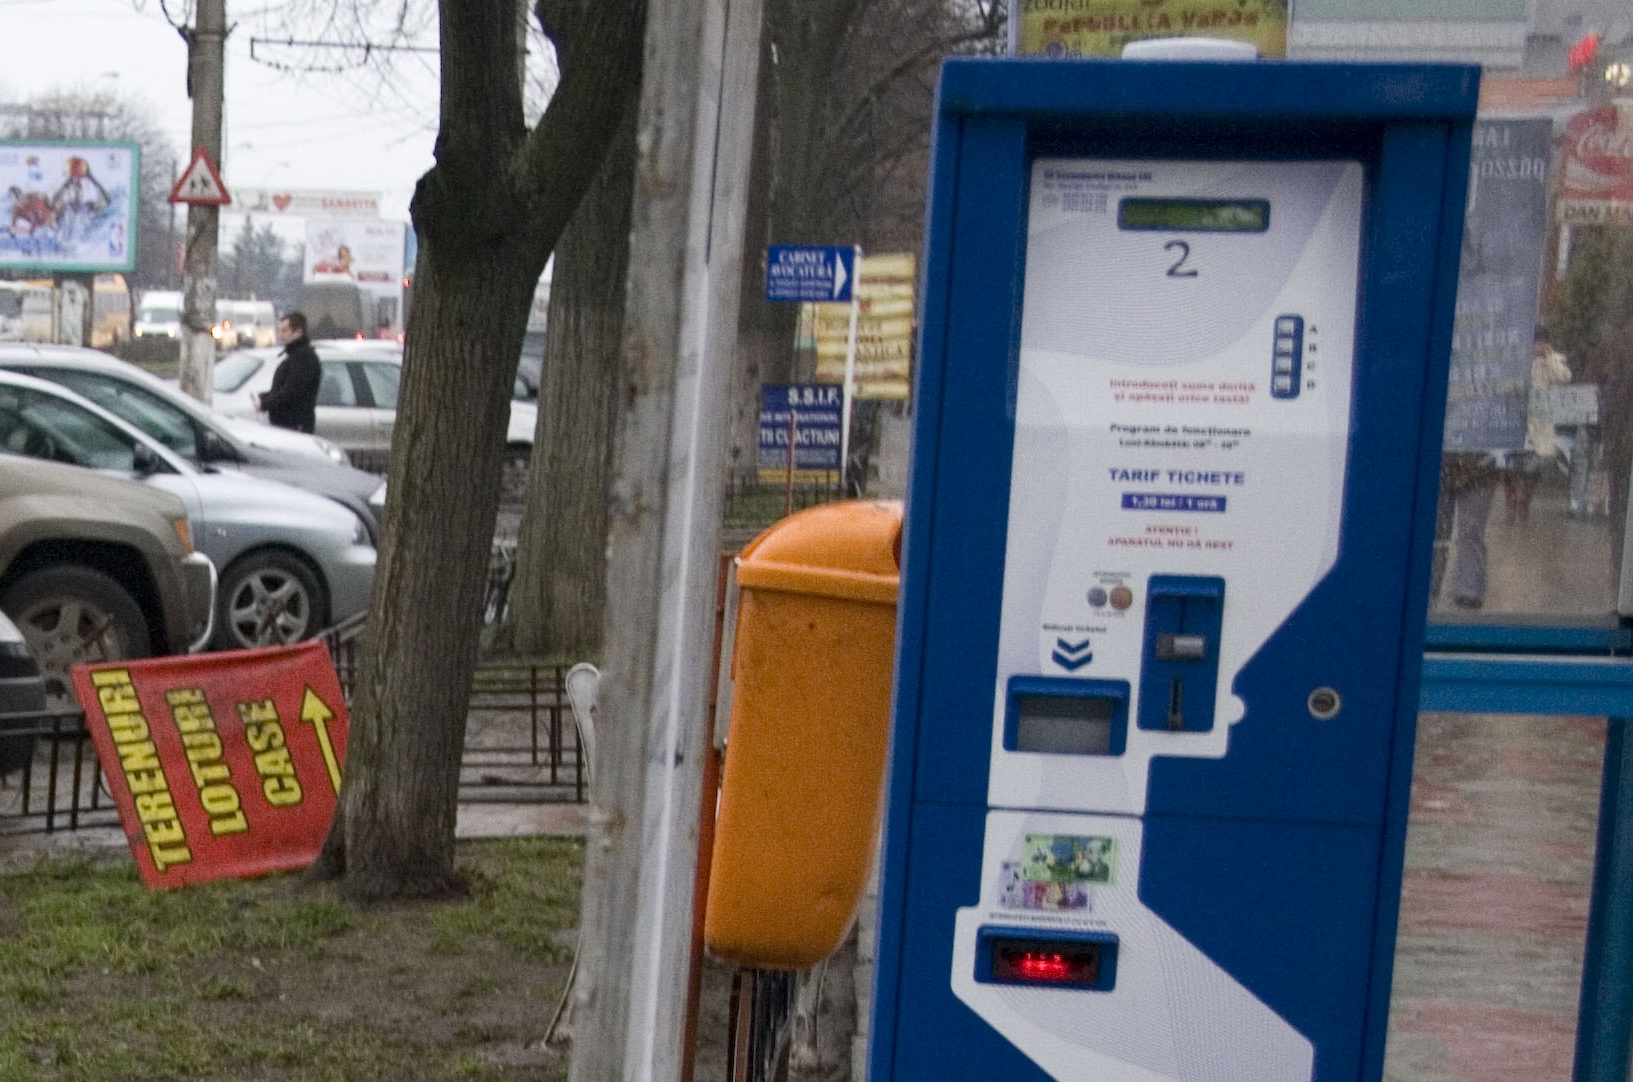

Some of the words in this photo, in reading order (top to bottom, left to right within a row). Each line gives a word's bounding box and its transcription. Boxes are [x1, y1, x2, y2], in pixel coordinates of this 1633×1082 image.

[779, 249, 826, 264] CABINET
[1163, 239, 1199, 278] 2
[1109, 468, 1160, 483] TARIF
[1167, 470, 1245, 487] TICHETE
[90, 667, 192, 873] TERENURI
[164, 687, 250, 836] LOTURI
[237, 698, 303, 807] CASE
